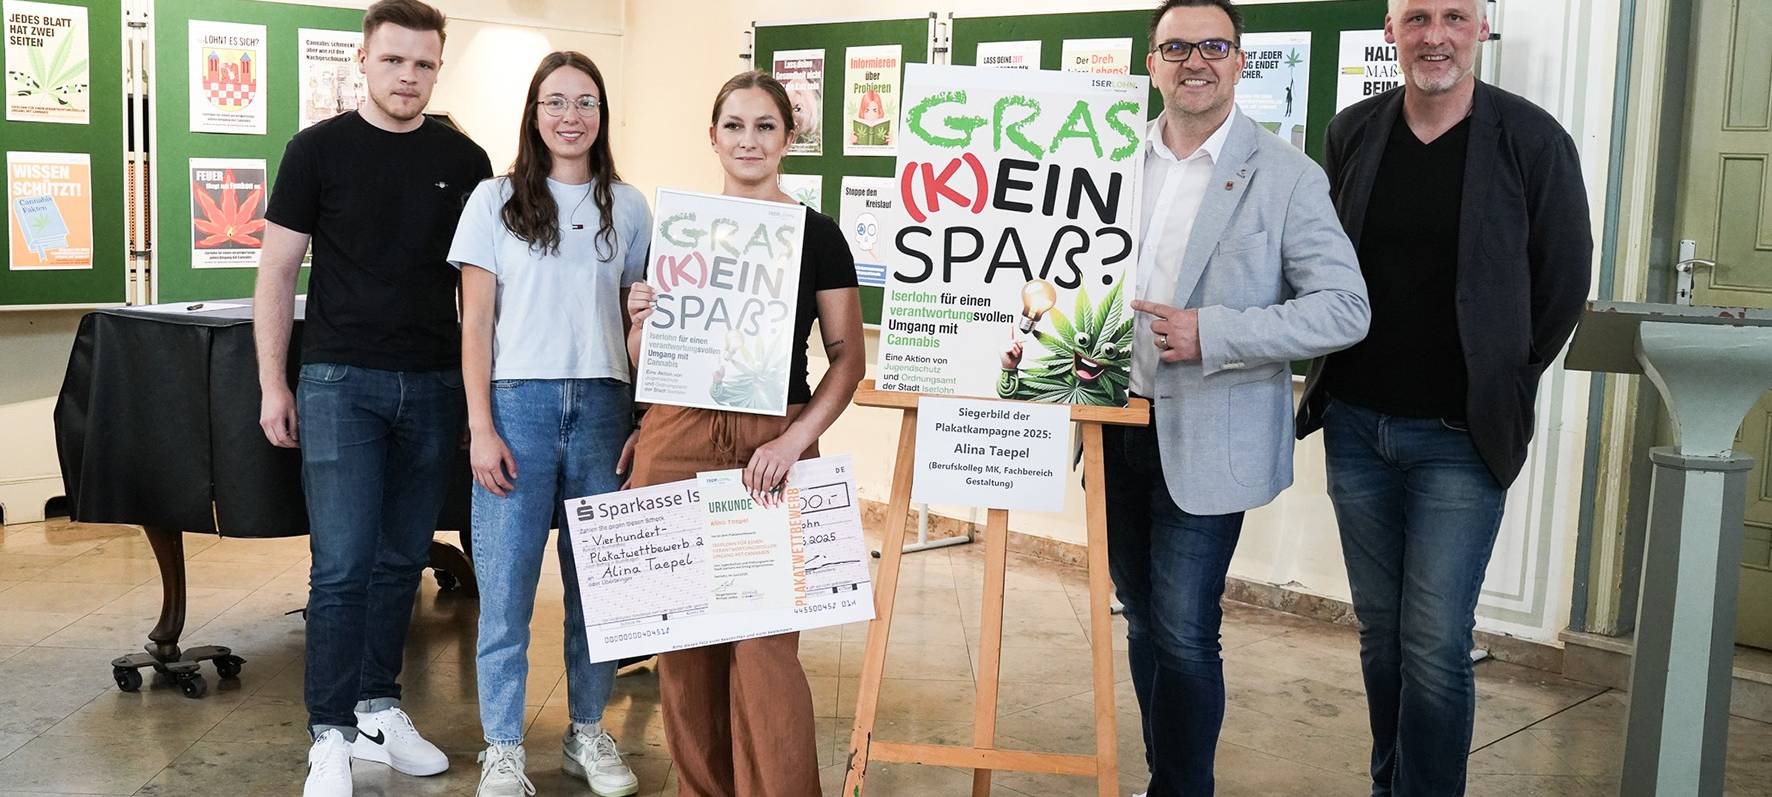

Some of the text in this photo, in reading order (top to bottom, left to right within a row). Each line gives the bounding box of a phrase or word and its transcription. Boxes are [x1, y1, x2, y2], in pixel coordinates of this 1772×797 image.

[9, 13, 72, 28] JEDES BLATT
[10, 25, 55, 37] HAT ZWEI
[10, 36, 43, 47] SEITEN
[1076, 54, 1114, 65] Der Dreh
[1259, 51, 1282, 60] JEDER
[1364, 46, 1398, 62] HALT
[850, 57, 896, 69] Informieren
[1256, 61, 1279, 69] ENDET
[865, 71, 880, 81] über
[854, 82, 891, 94] Probieren
[906, 89, 1140, 162] GRAS
[13, 164, 70, 179] WISSEN
[196, 170, 223, 182] FEUER
[13, 182, 81, 197] SCHÜTZT!
[845, 187, 877, 197] Stoppe den
[901, 152, 1122, 225] (K)EIN
[866, 200, 892, 208] Kreislauf
[660, 212, 795, 260] GRAS
[656, 251, 784, 299] (K)EIN
[891, 290, 991, 307] Iserlohn für einen
[890, 306, 1014, 324] verantwortungsvollen
[888, 319, 958, 336] Umgang mit
[887, 334, 940, 348] Cannabis
[648, 350, 676, 360] Umgang
[886, 353, 948, 365] Eine Aktion von
[884, 363, 942, 374] Jugendschutz
[900, 374, 957, 385] Ordnungsamt
[882, 382, 955, 394] der Stadt Iserlohn
[958, 408, 1030, 420] Siegerbild der
[935, 422, 1052, 440] Plakatkampagne 2025:
[954, 443, 1030, 460] Alina Taepel
[835, 466, 846, 474] DE
[928, 462, 1053, 477] (Berufskolleg MK, Fachbereich
[966, 478, 1014, 489] Gestaltung)
[598, 494, 682, 520] Sparkasse
[708, 498, 752, 513] URKUNDE
[590, 538, 690, 564] Plakatwettbewerb
[787, 487, 808, 606] PLAKATWETTBEWERB
[602, 566, 640, 578] Alina
[645, 554, 693, 572] Taepel
